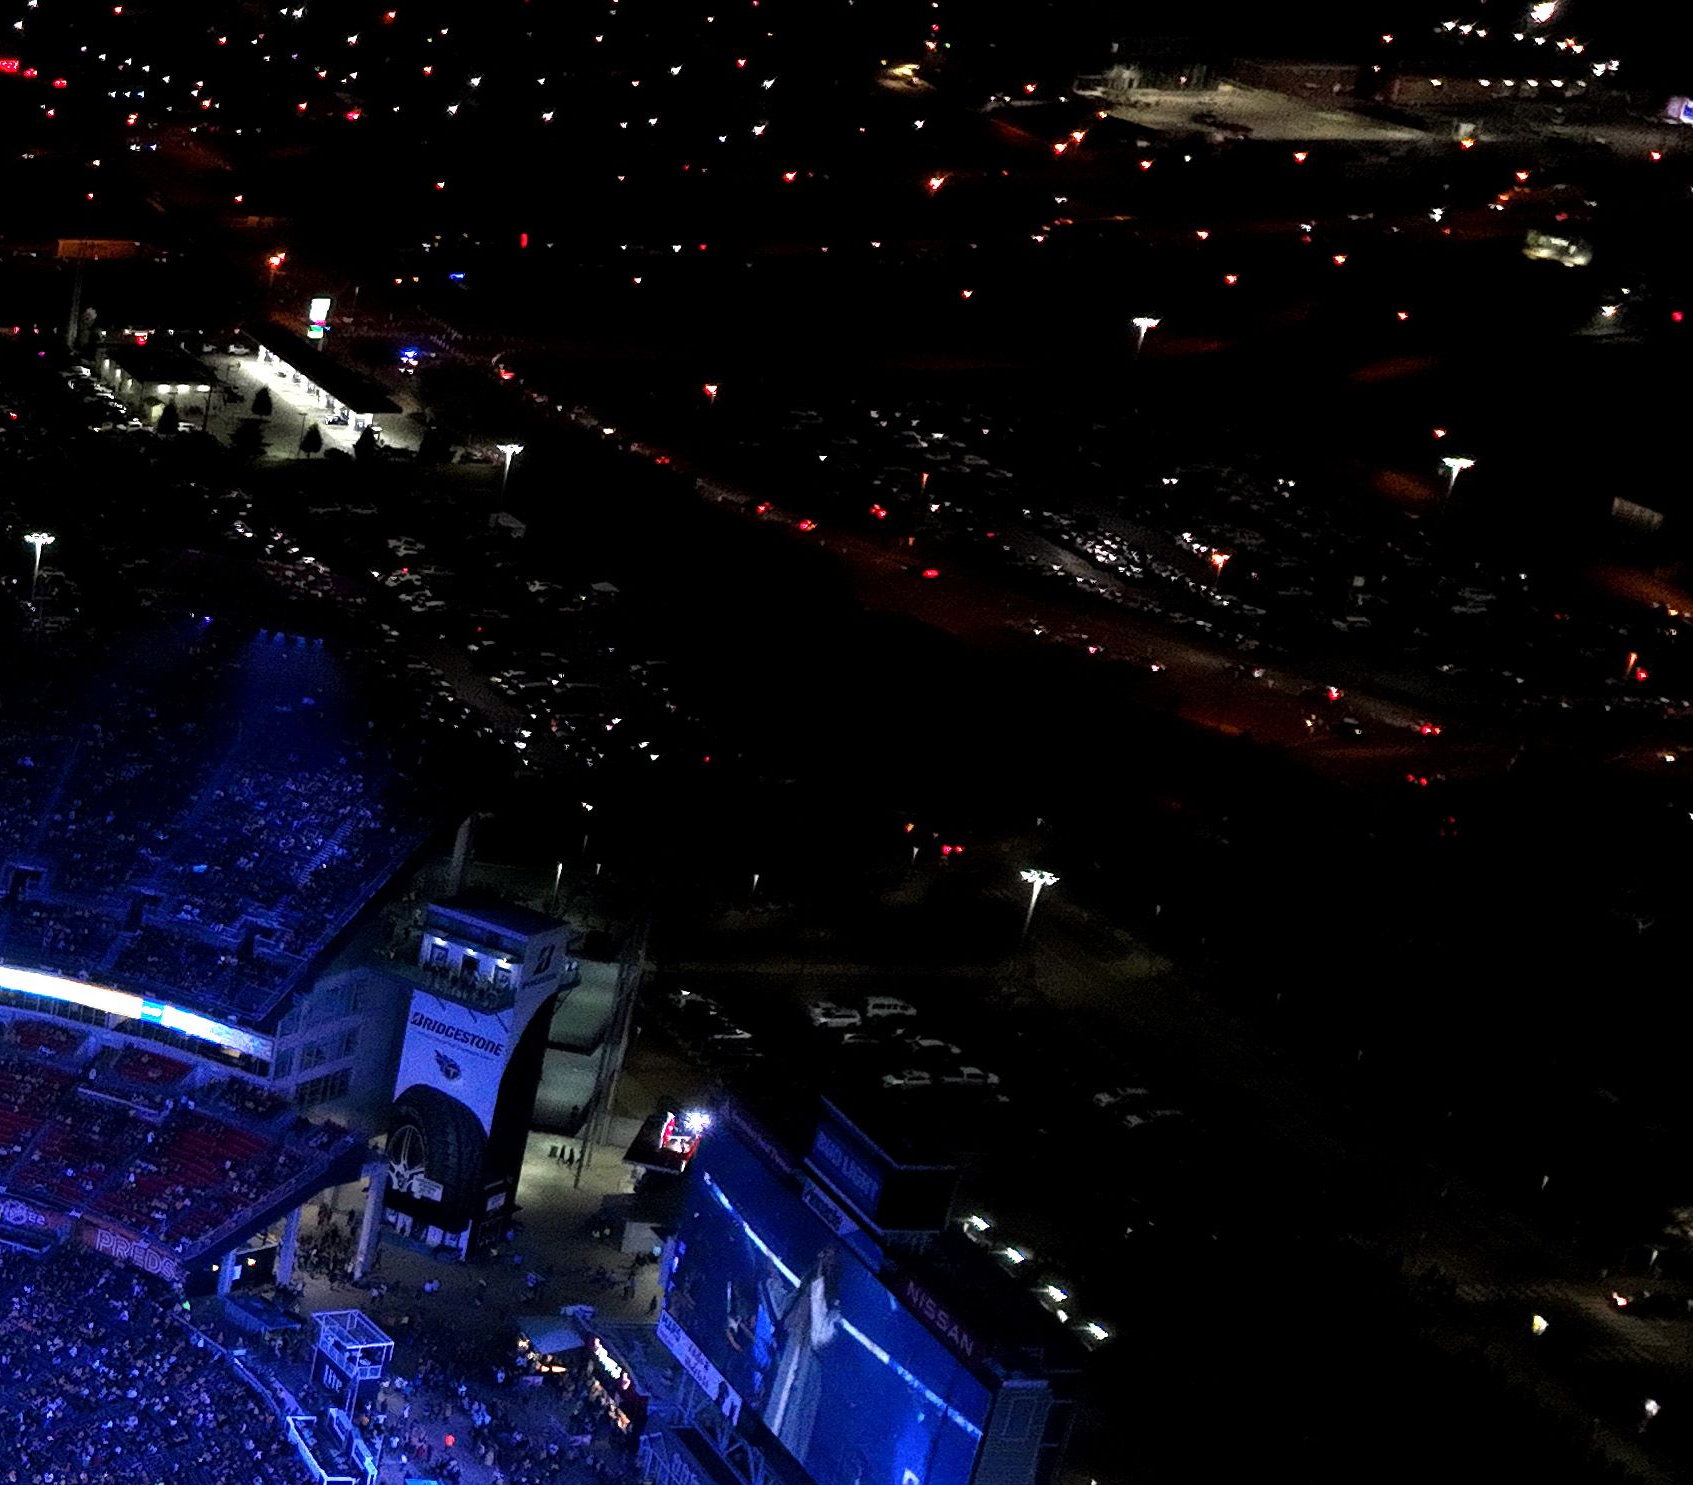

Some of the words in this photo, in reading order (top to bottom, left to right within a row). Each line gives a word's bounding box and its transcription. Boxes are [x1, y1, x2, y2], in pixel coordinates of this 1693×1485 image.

[411, 1012, 505, 1056] BRIDGESTONE
[95, 1228, 178, 1282] PREDS
[906, 1279, 974, 1357] NISSAN
